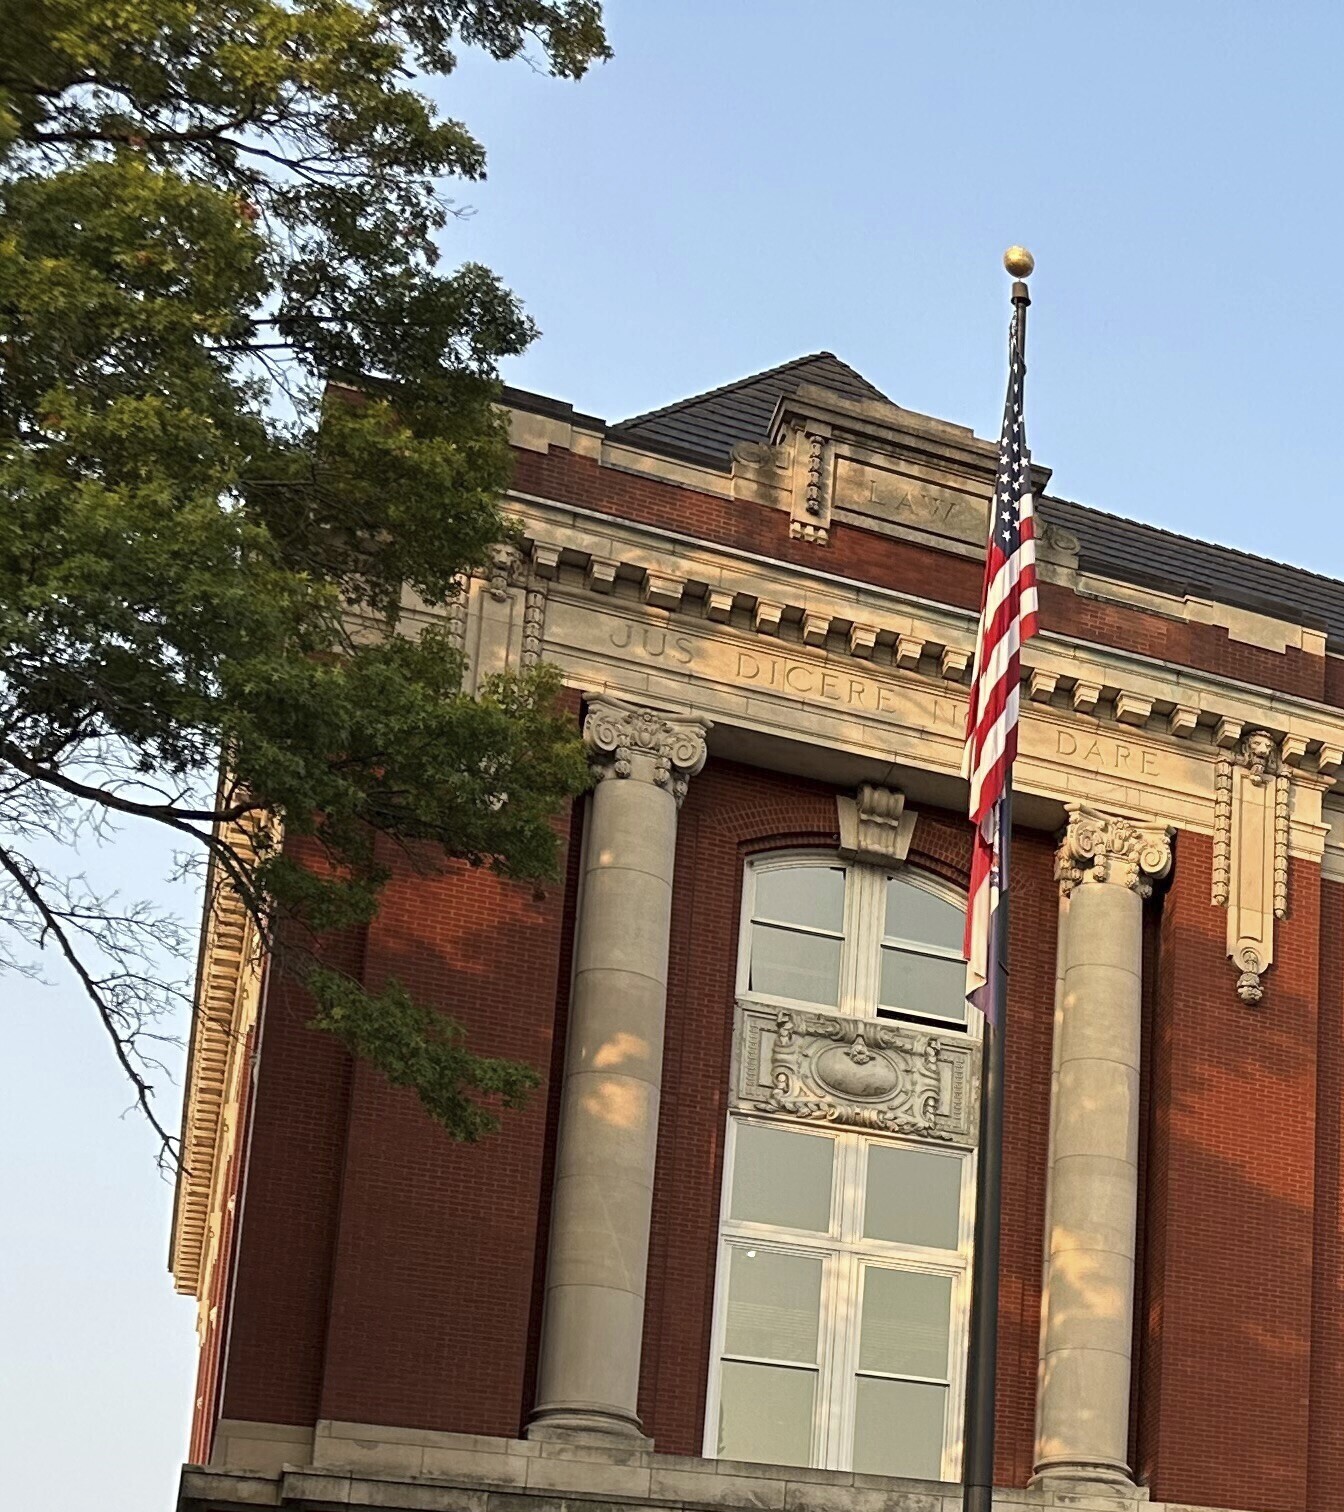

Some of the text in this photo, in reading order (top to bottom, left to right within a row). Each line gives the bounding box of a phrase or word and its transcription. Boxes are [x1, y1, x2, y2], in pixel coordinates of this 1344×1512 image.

[868, 479, 956, 522] LAW
[609, 623, 695, 665] JUS
[736, 652, 898, 714] DICERE
[1055, 729, 1161, 777] DARE
